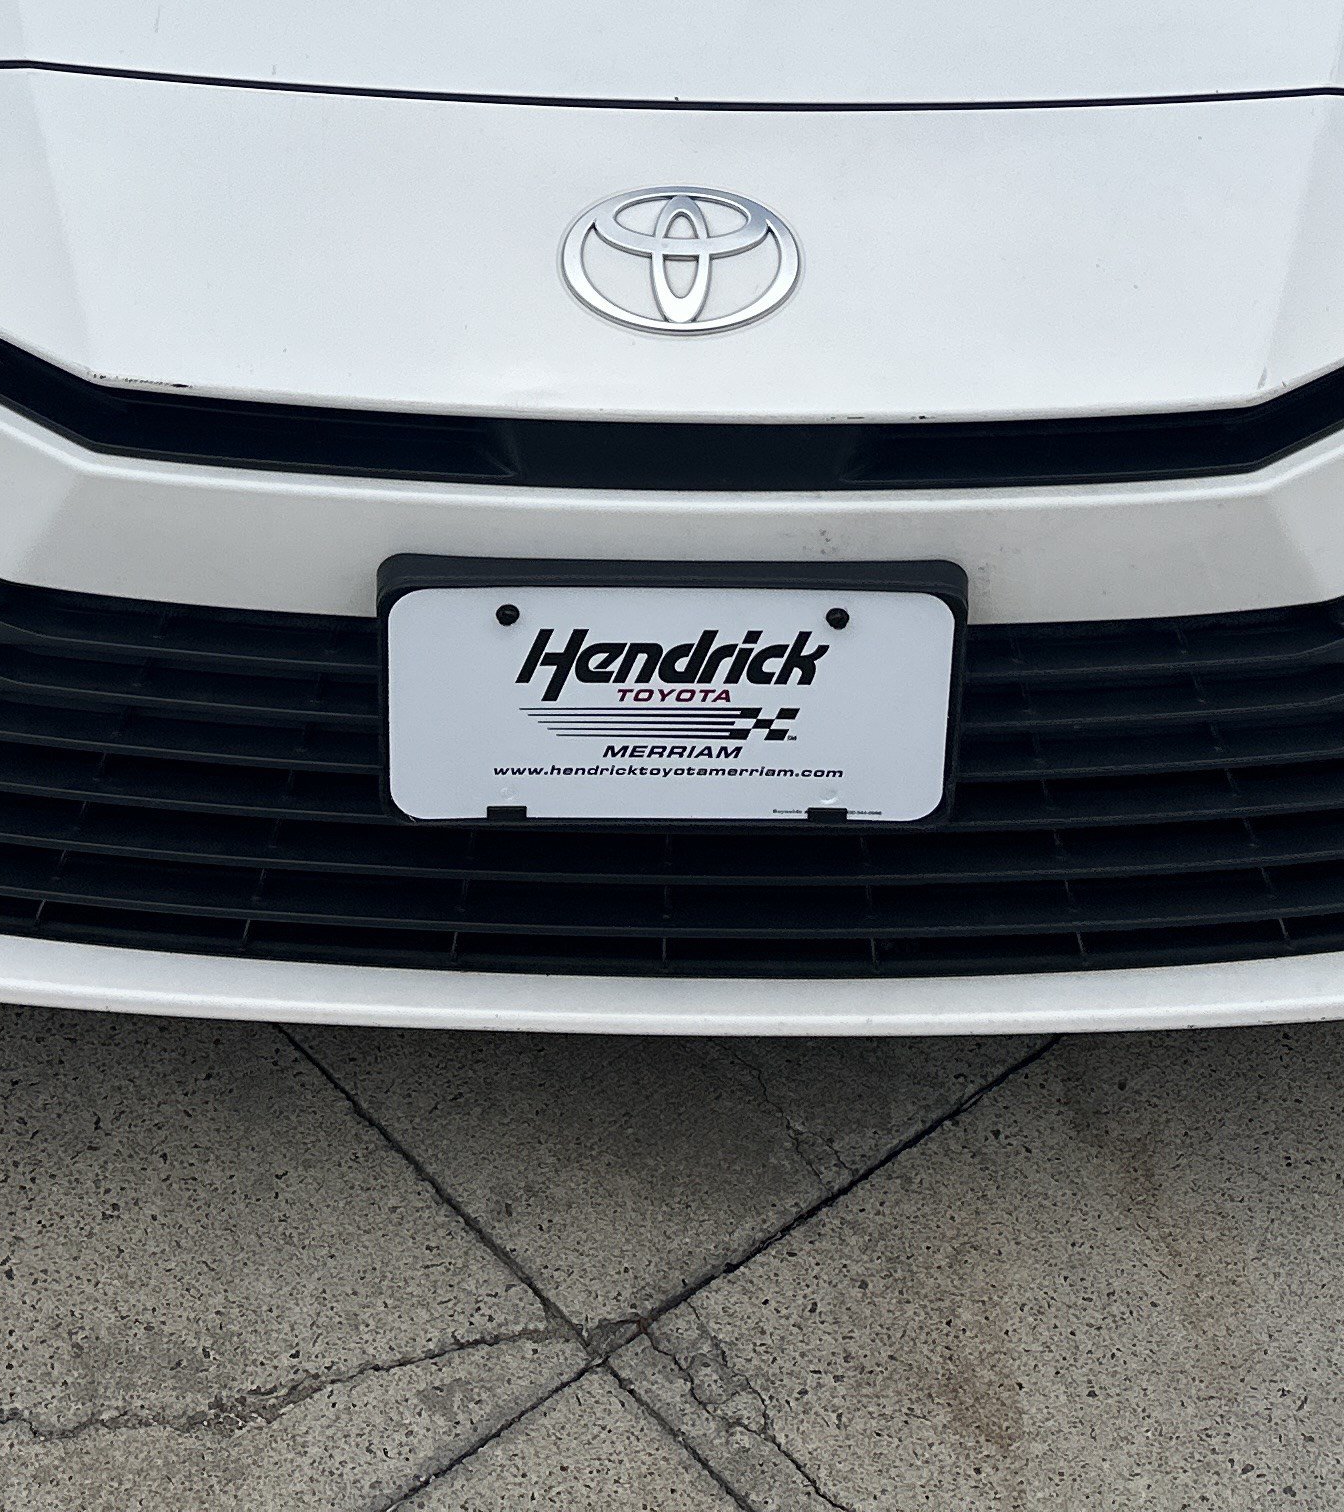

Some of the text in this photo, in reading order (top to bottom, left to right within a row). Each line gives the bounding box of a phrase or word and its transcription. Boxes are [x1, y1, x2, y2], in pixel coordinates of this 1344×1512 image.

[514, 628, 830, 702] Hendrick
[617, 688, 731, 703] TOYOTA
[602, 745, 744, 759] MERRIAM
[493, 764, 844, 778] www.hendricktoyotamerriam.com
